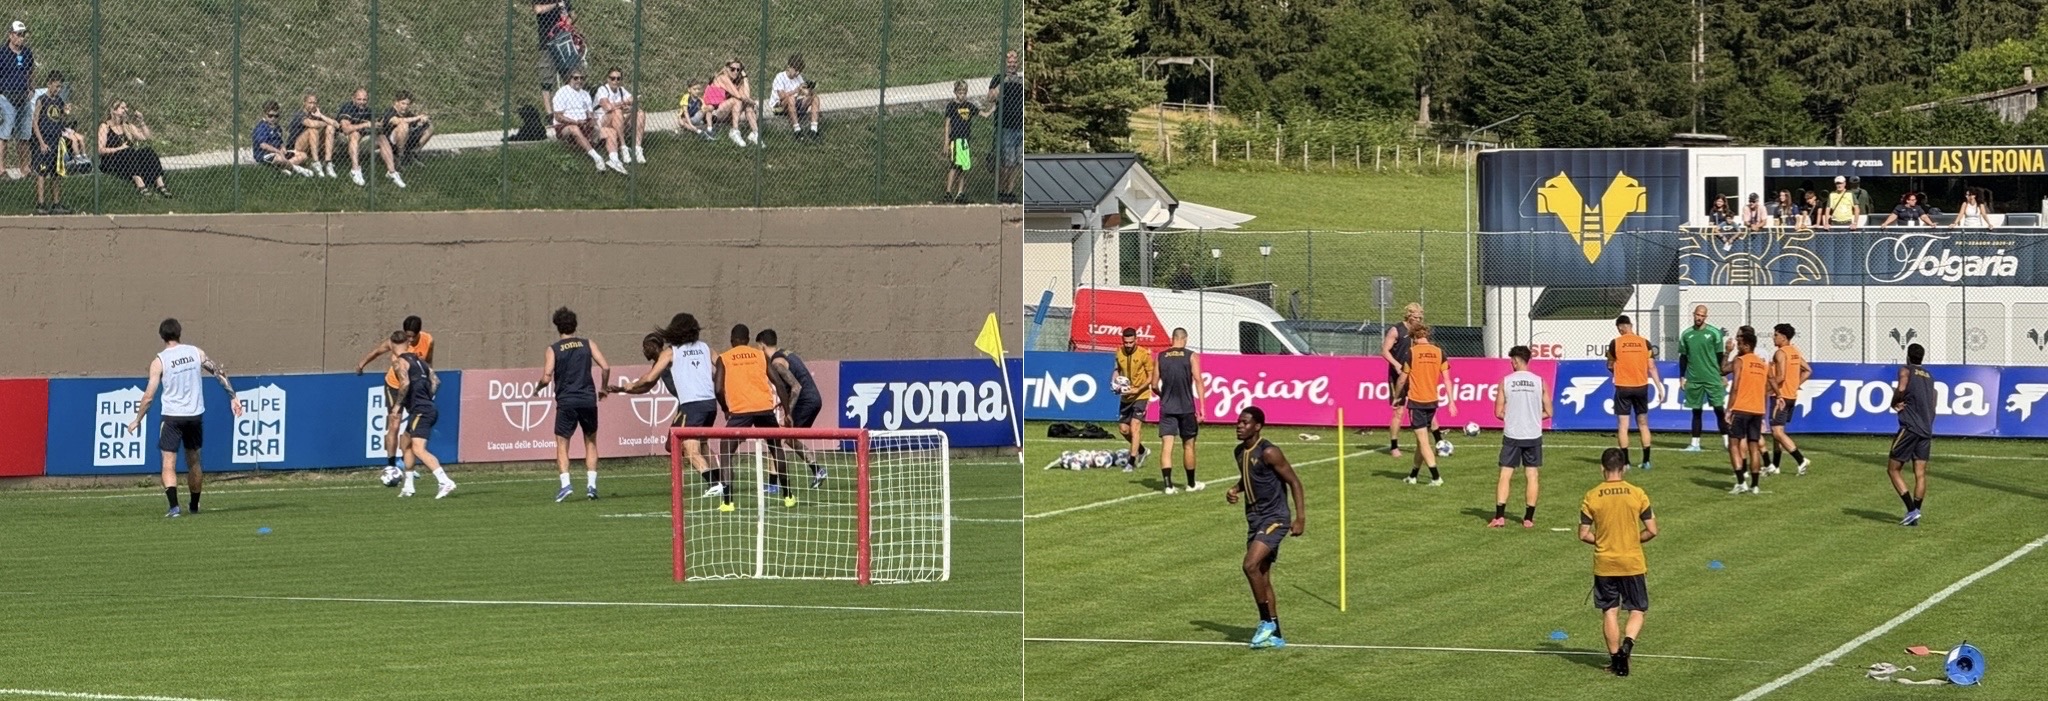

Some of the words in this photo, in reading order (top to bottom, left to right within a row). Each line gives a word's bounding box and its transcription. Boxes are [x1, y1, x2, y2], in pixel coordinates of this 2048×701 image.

[1892, 150, 1963, 174] HELLAS
[1967, 149, 2045, 173] VERONA
[1865, 233, 2018, 283] Folgaria
[101, 400, 142, 415] ALPE
[242, 398, 280, 413] ALPE
[238, 419, 281, 436] CIM
[237, 438, 280, 456] BRA
[487, 441, 514, 451] L'acqua
[514, 440, 531, 449] delle
[532, 439, 558, 449] Dolom
[618, 436, 642, 446] L'acqua
[99, 441, 141, 459] BRA
